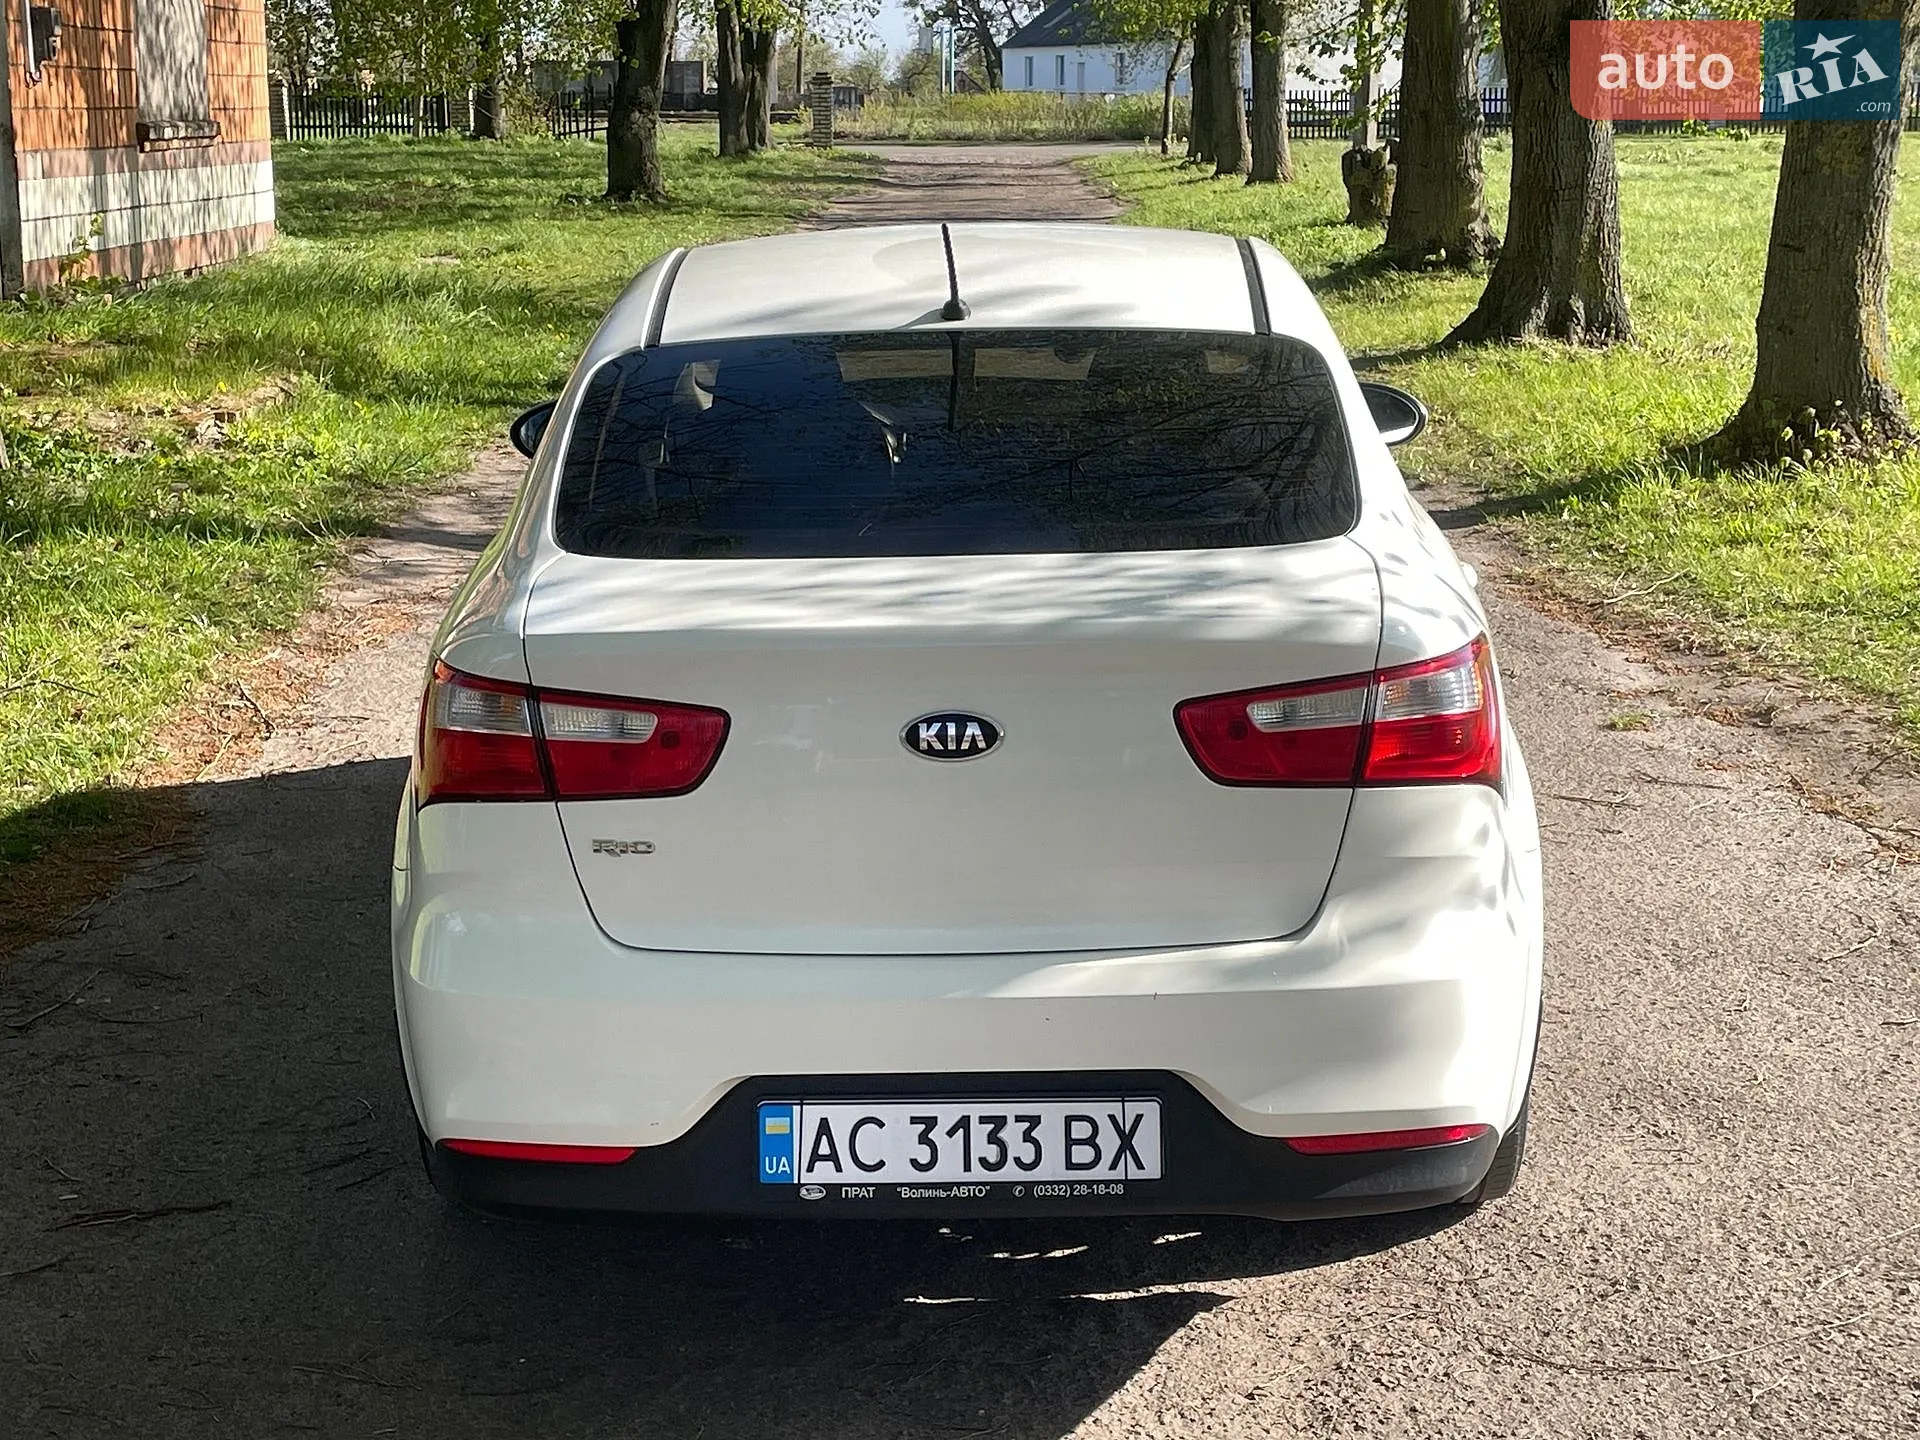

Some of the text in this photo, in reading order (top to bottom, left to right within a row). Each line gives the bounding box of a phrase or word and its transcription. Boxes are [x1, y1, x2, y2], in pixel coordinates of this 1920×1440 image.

[917, 722, 988, 750] KIA
[592, 839, 656, 857] RIO
[806, 1113, 1146, 1173] AC 3133 BX
[765, 1156, 791, 1174] UA
[841, 1184, 1124, 1199] ПРАТ "Волинь-АВТО" (0332) 28-18-08
